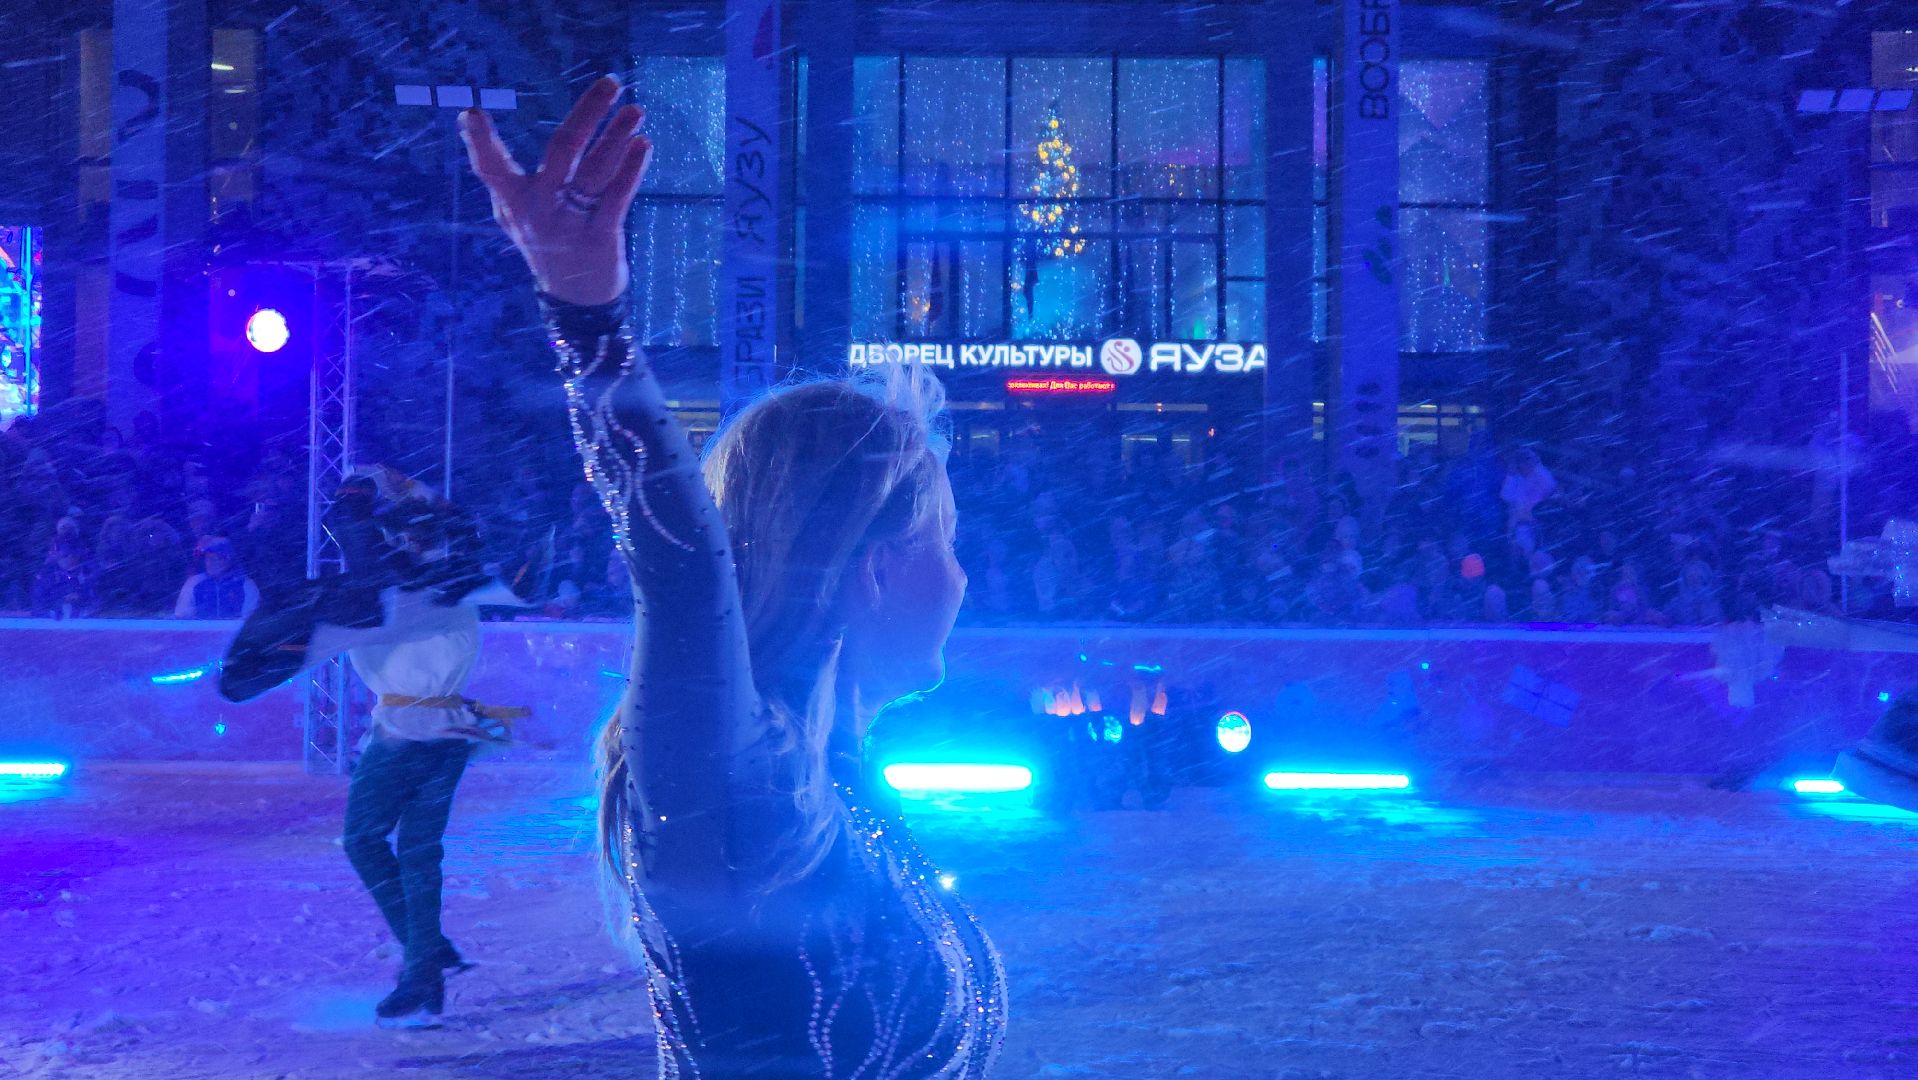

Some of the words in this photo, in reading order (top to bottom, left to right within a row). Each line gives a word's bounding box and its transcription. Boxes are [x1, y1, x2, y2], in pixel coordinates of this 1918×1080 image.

[735, 116, 772, 244] ЯУЗУ
[850, 343, 954, 369] ДВОРЕЦ
[960, 344, 1093, 367] КУЛЬТУРЫ
[1150, 343, 1265, 373] ЯУЗА
